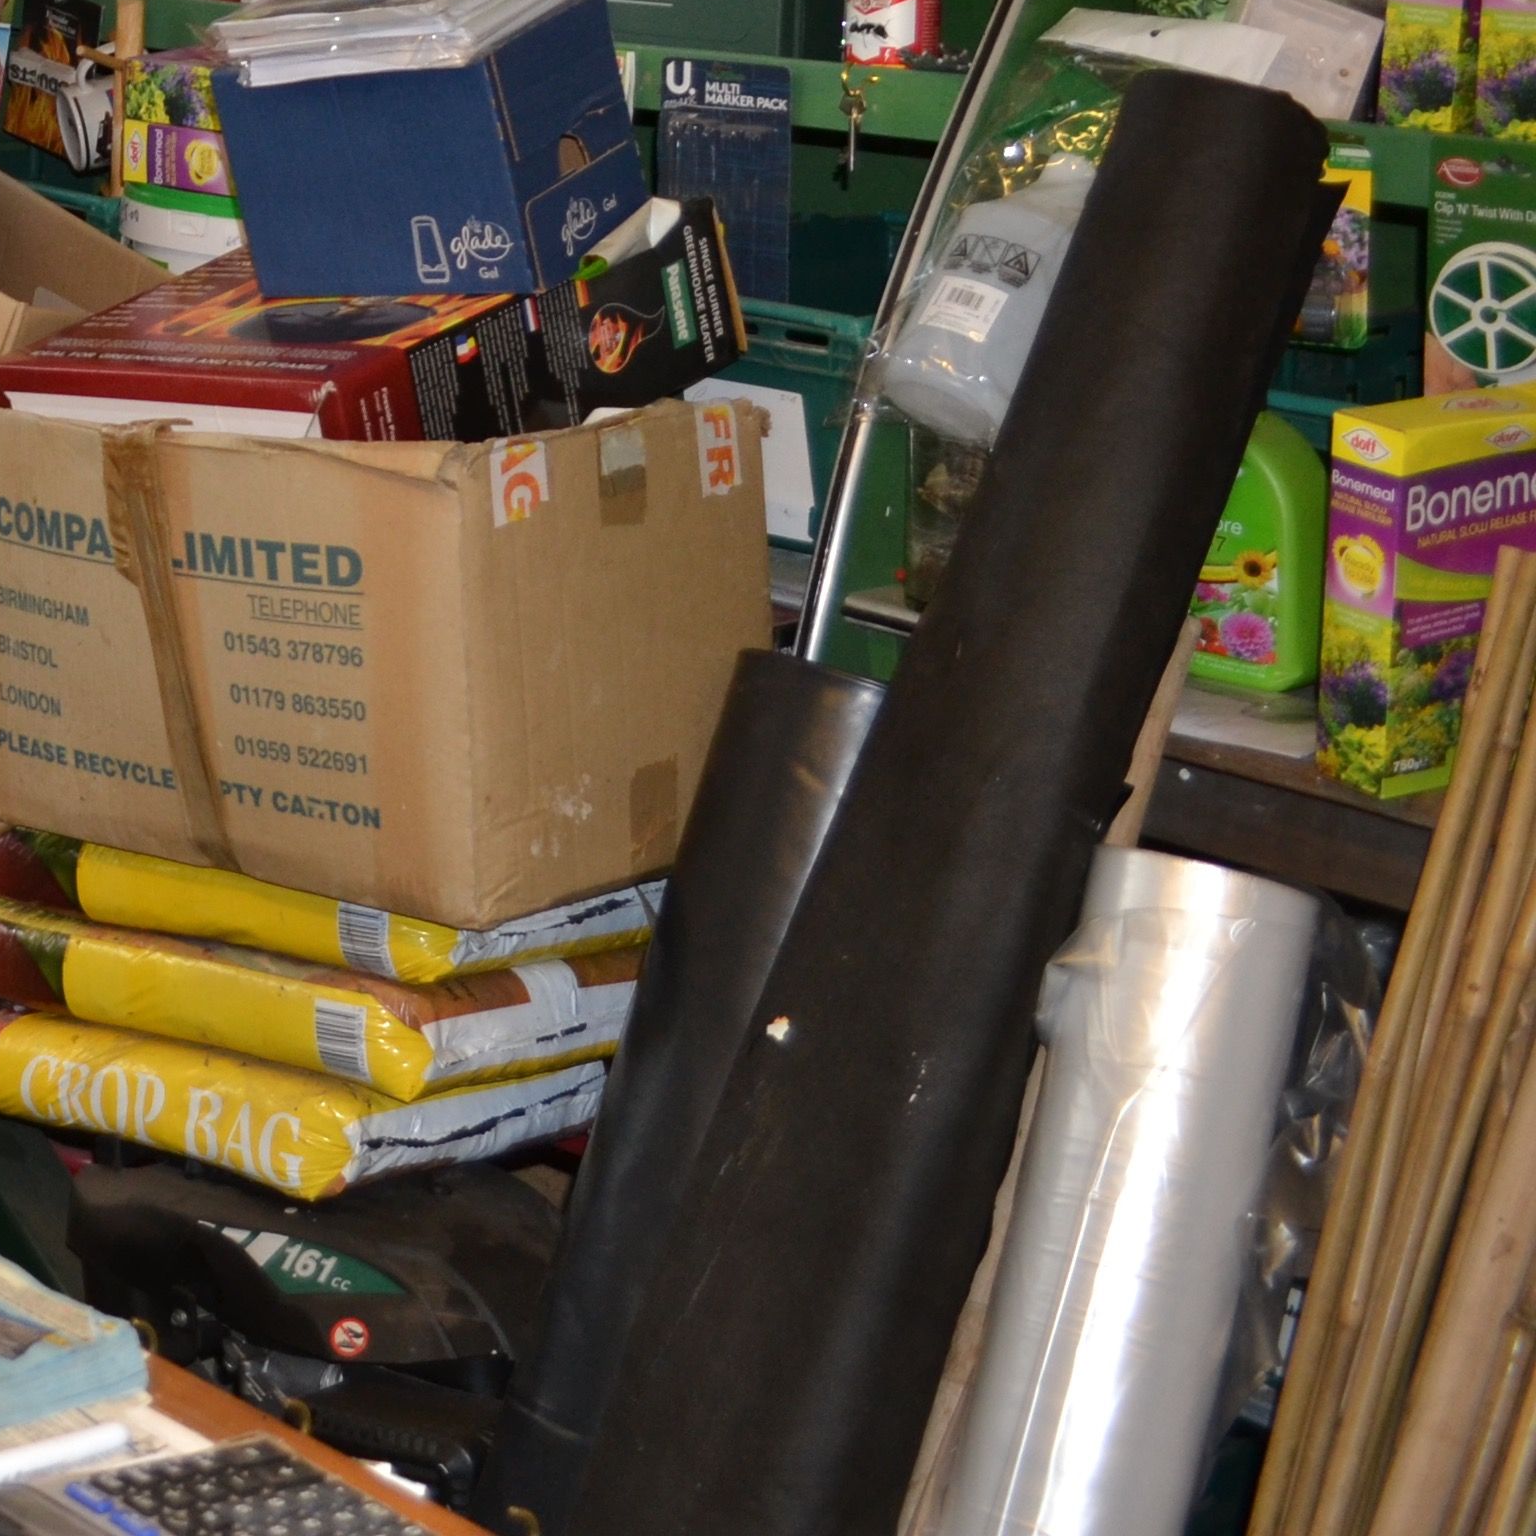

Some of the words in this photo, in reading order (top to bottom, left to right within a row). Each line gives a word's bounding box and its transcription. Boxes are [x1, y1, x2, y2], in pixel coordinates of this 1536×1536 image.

[704, 80, 741, 96] MULTI
[704, 92, 753, 109] MARKER
[754, 95, 788, 112] PACK
[559, 197, 598, 257] glade
[1433, 199, 1454, 216] Clip
[1472, 203, 1496, 219] Twist
[1497, 205, 1523, 222] With
[449, 227, 514, 270] glade
[698, 235, 715, 282] SINGLE
[478, 264, 500, 280] Gel
[665, 263, 692, 342] Parasene
[682, 224, 706, 313] GREENHOUSE
[699, 312, 715, 364] HEATER
[706, 283, 725, 339] BURNER
[1349, 434, 1377, 454] doff
[1331, 468, 1396, 502] Bonemeal
[1416, 528, 1458, 548] NATURAL
[1459, 521, 1489, 538] SLOW
[1489, 512, 1529, 533] RELEASE
[246, 592, 363, 627] TELEPHONE
[223, 629, 282, 659] 01543
[287, 637, 365, 669] 378796
[228, 682, 287, 712] 01179
[291, 690, 367, 723] 863550
[233, 734, 292, 765] 01959
[296, 743, 370, 776] 522691
[73, 745, 177, 792] RECYCLE
[218, 779, 264, 811] PTY
[19, 1053, 168, 1143] CROP
[184, 1086, 305, 1191] BAG
